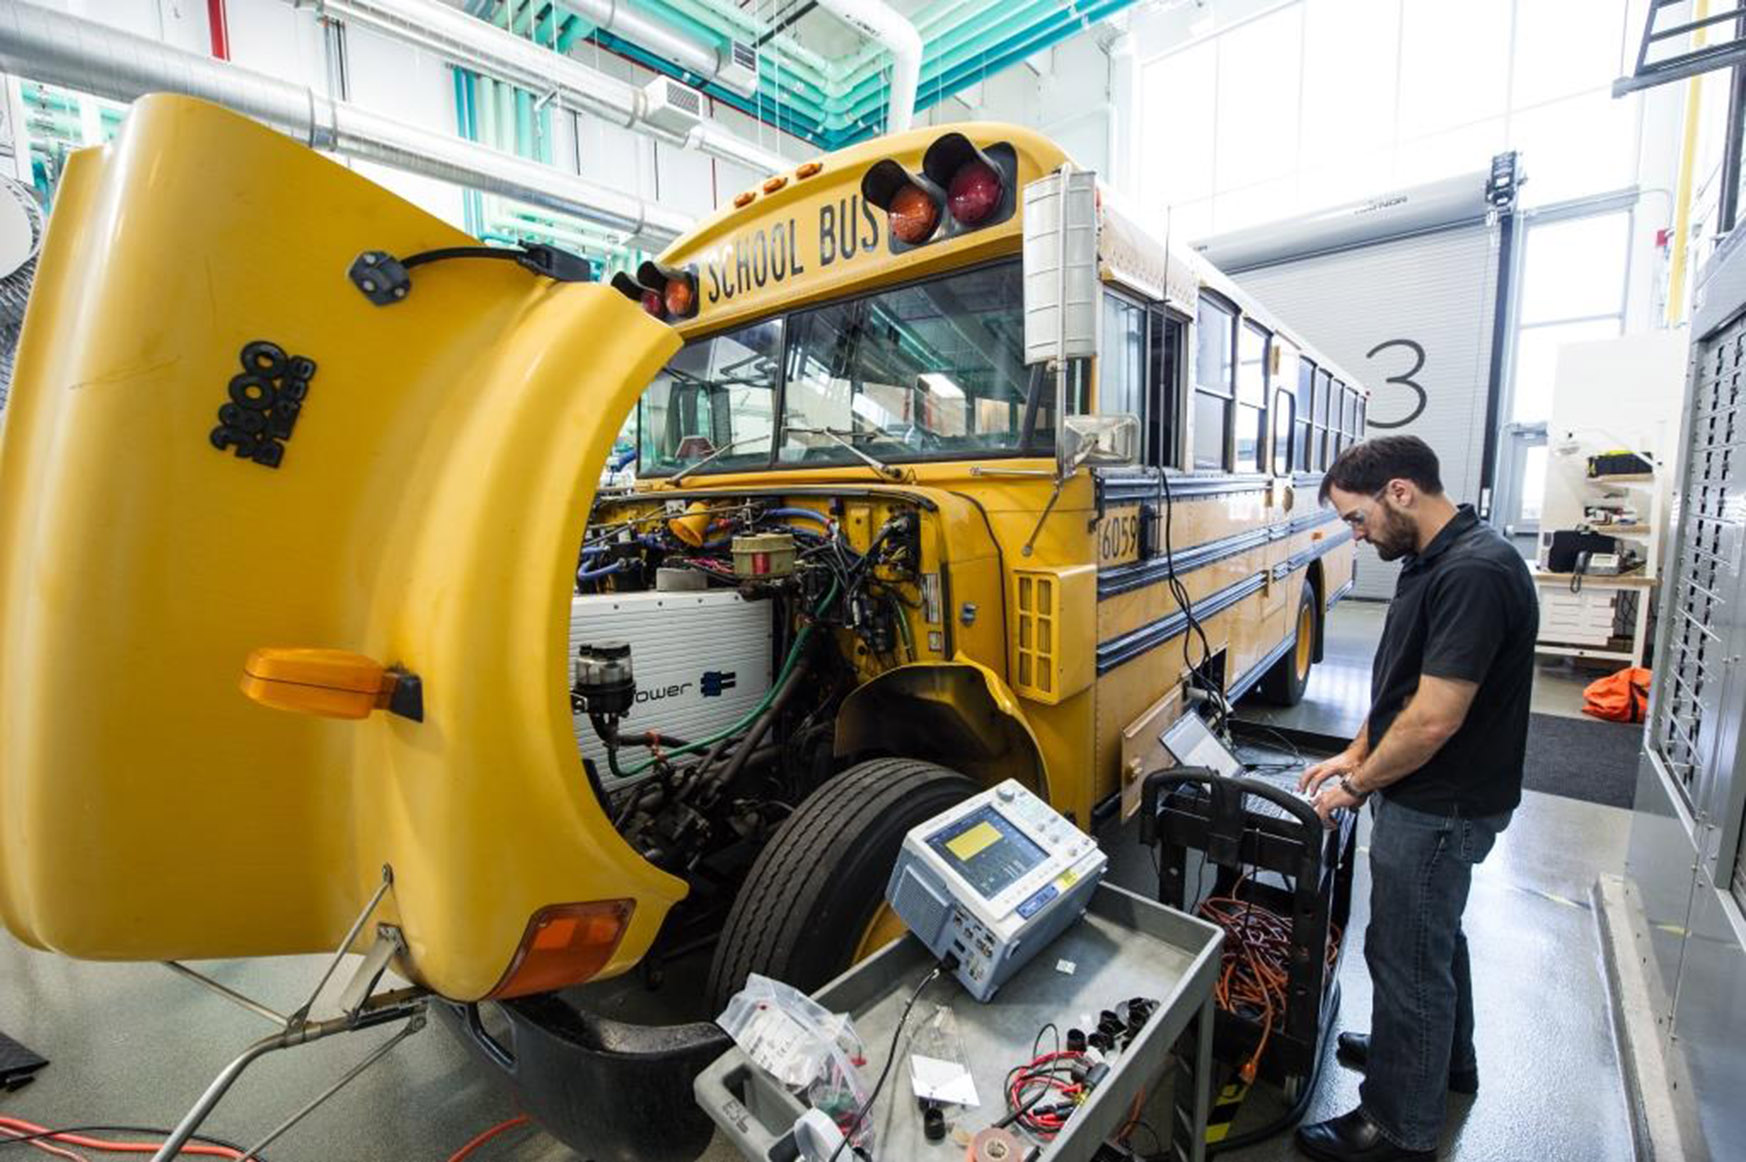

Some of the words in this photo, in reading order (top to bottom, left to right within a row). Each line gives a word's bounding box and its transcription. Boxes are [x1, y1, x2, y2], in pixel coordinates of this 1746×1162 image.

[708, 218, 804, 303] SCHOOL
[819, 194, 879, 267] BUS
[1365, 338, 1428, 429] 3
[1102, 515, 1138, 560] 6059
